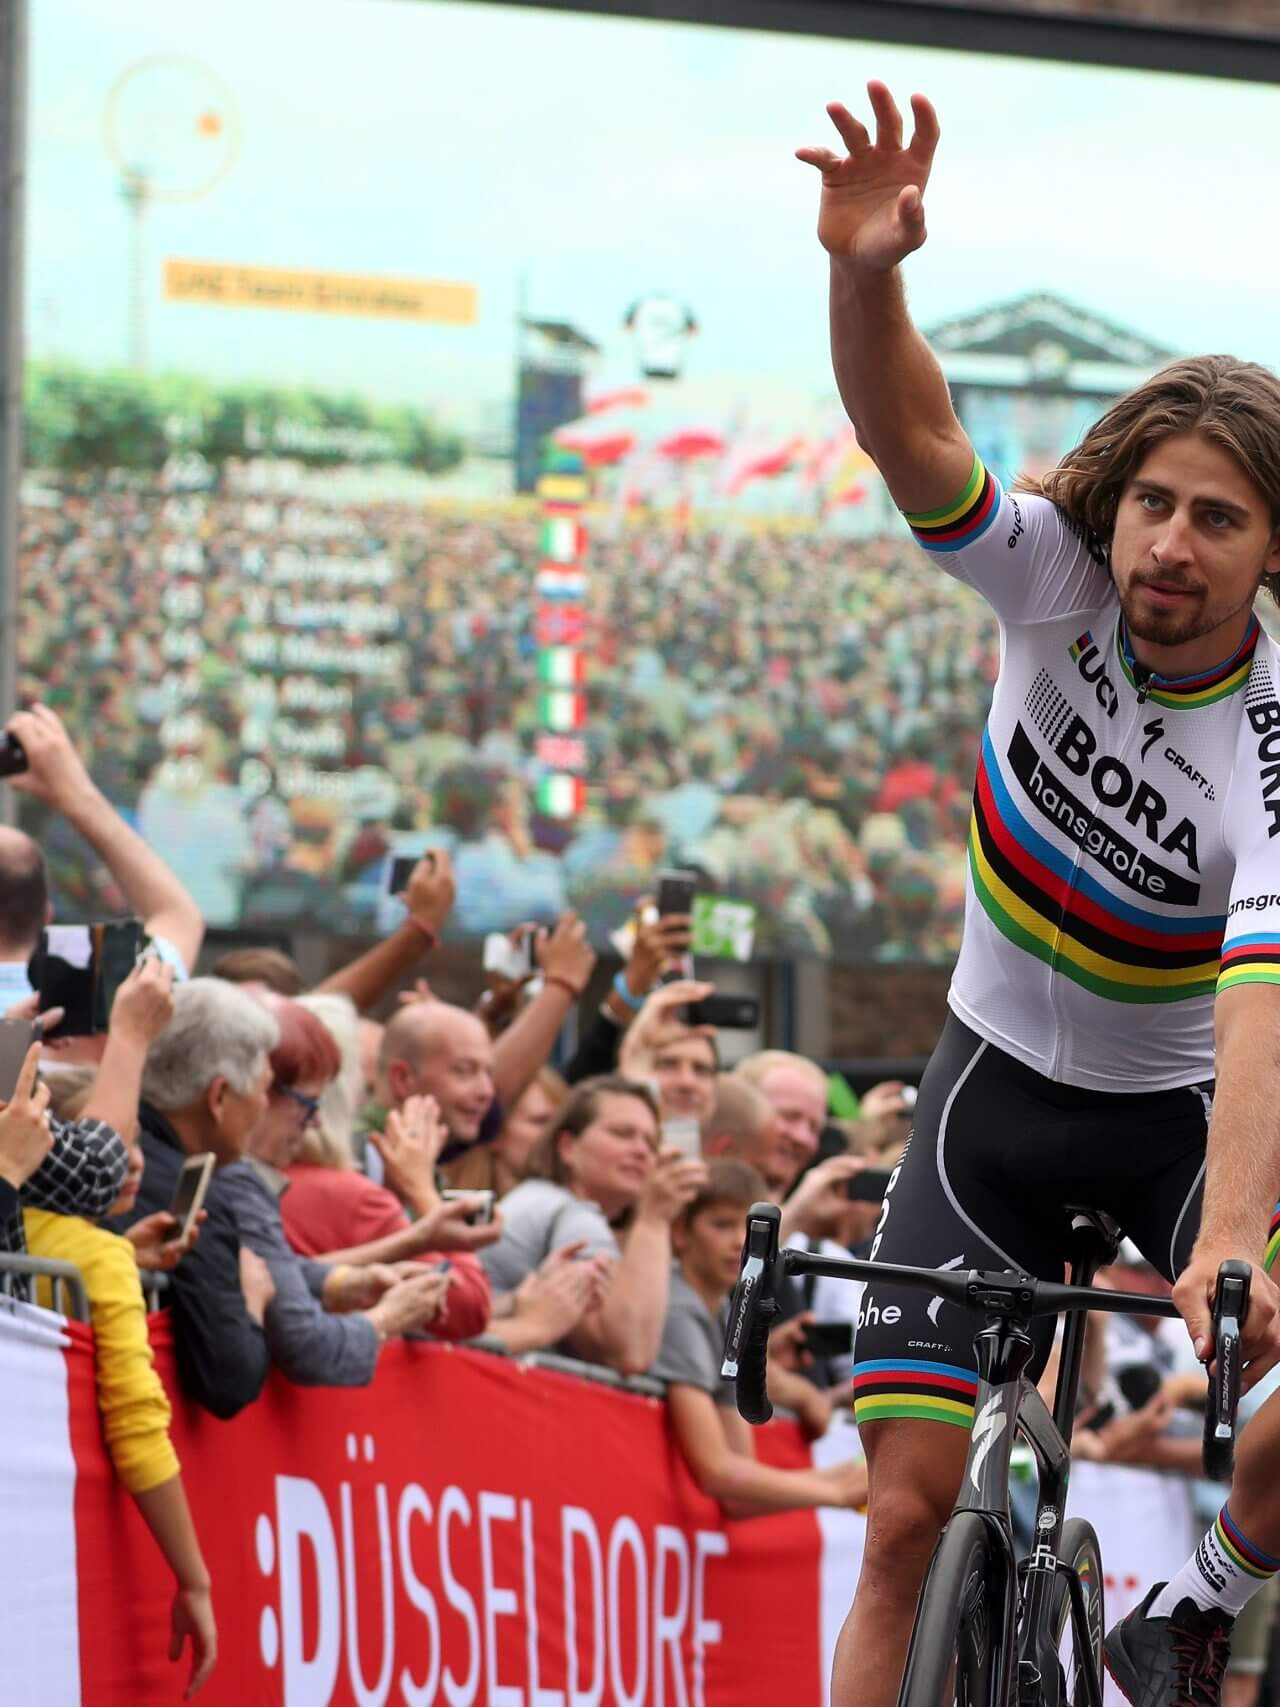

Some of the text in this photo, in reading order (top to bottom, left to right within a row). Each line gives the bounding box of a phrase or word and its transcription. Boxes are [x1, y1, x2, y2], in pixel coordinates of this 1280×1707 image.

[1078, 645, 1119, 719] UCI
[1055, 702, 1200, 873] BORA
[1164, 747, 1208, 789] CRAFT
[1029, 763, 1167, 893] hansgrohe
[907, 1340, 943, 1351] CRAFT
